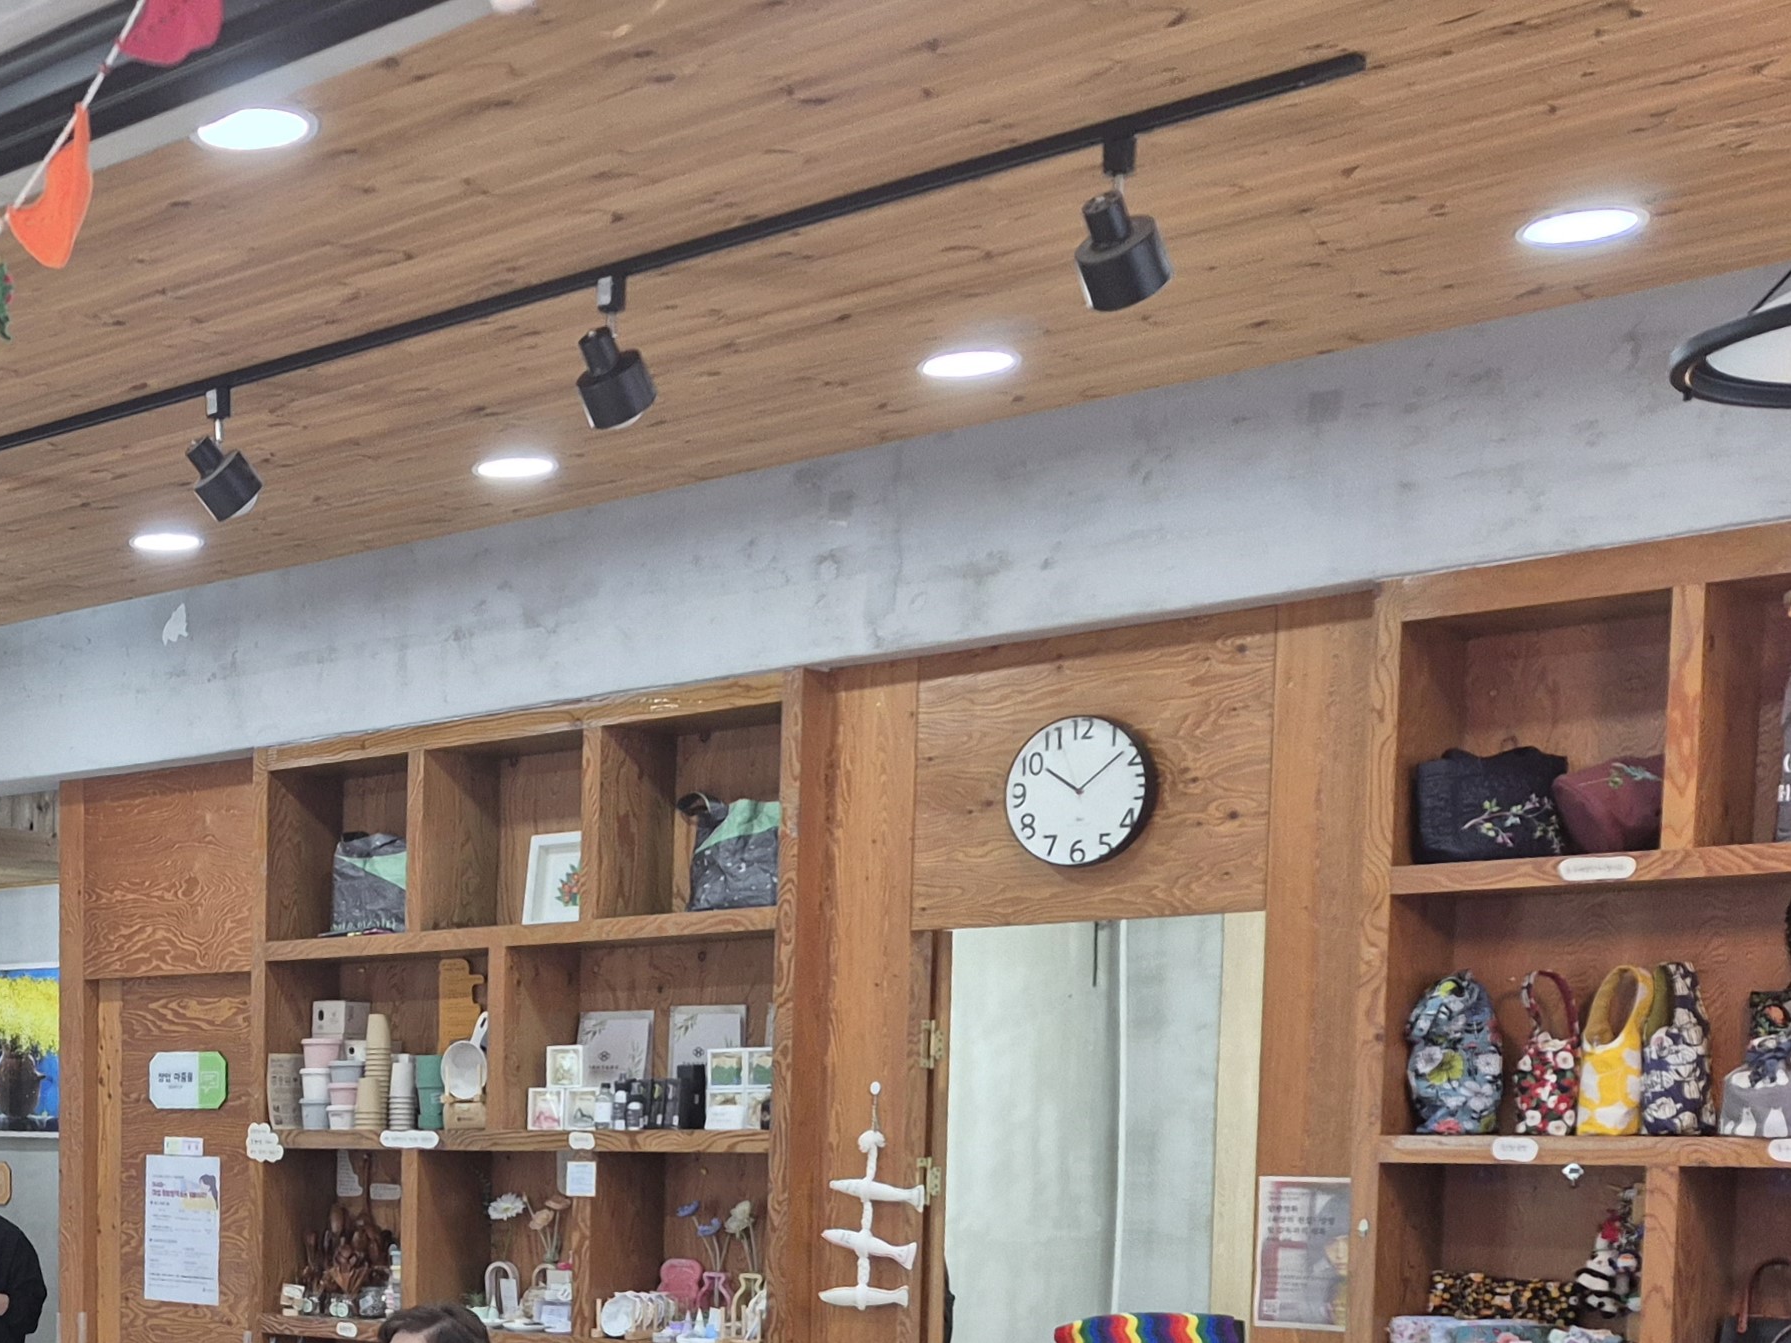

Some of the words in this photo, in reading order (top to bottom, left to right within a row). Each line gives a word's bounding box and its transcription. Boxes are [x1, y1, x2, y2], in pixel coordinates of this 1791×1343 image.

[1044, 726, 1063, 751] 11
[1071, 718, 1094, 740] 12
[1108, 723, 1117, 747] 1
[1021, 752, 1044, 777] 10
[1012, 782, 1027, 809] 9
[1020, 813, 1036, 840] 8
[1119, 807, 1136, 829] 4
[1043, 834, 1058, 857] 7
[1069, 839, 1086, 863] 6
[1099, 832, 1116, 857] 5
